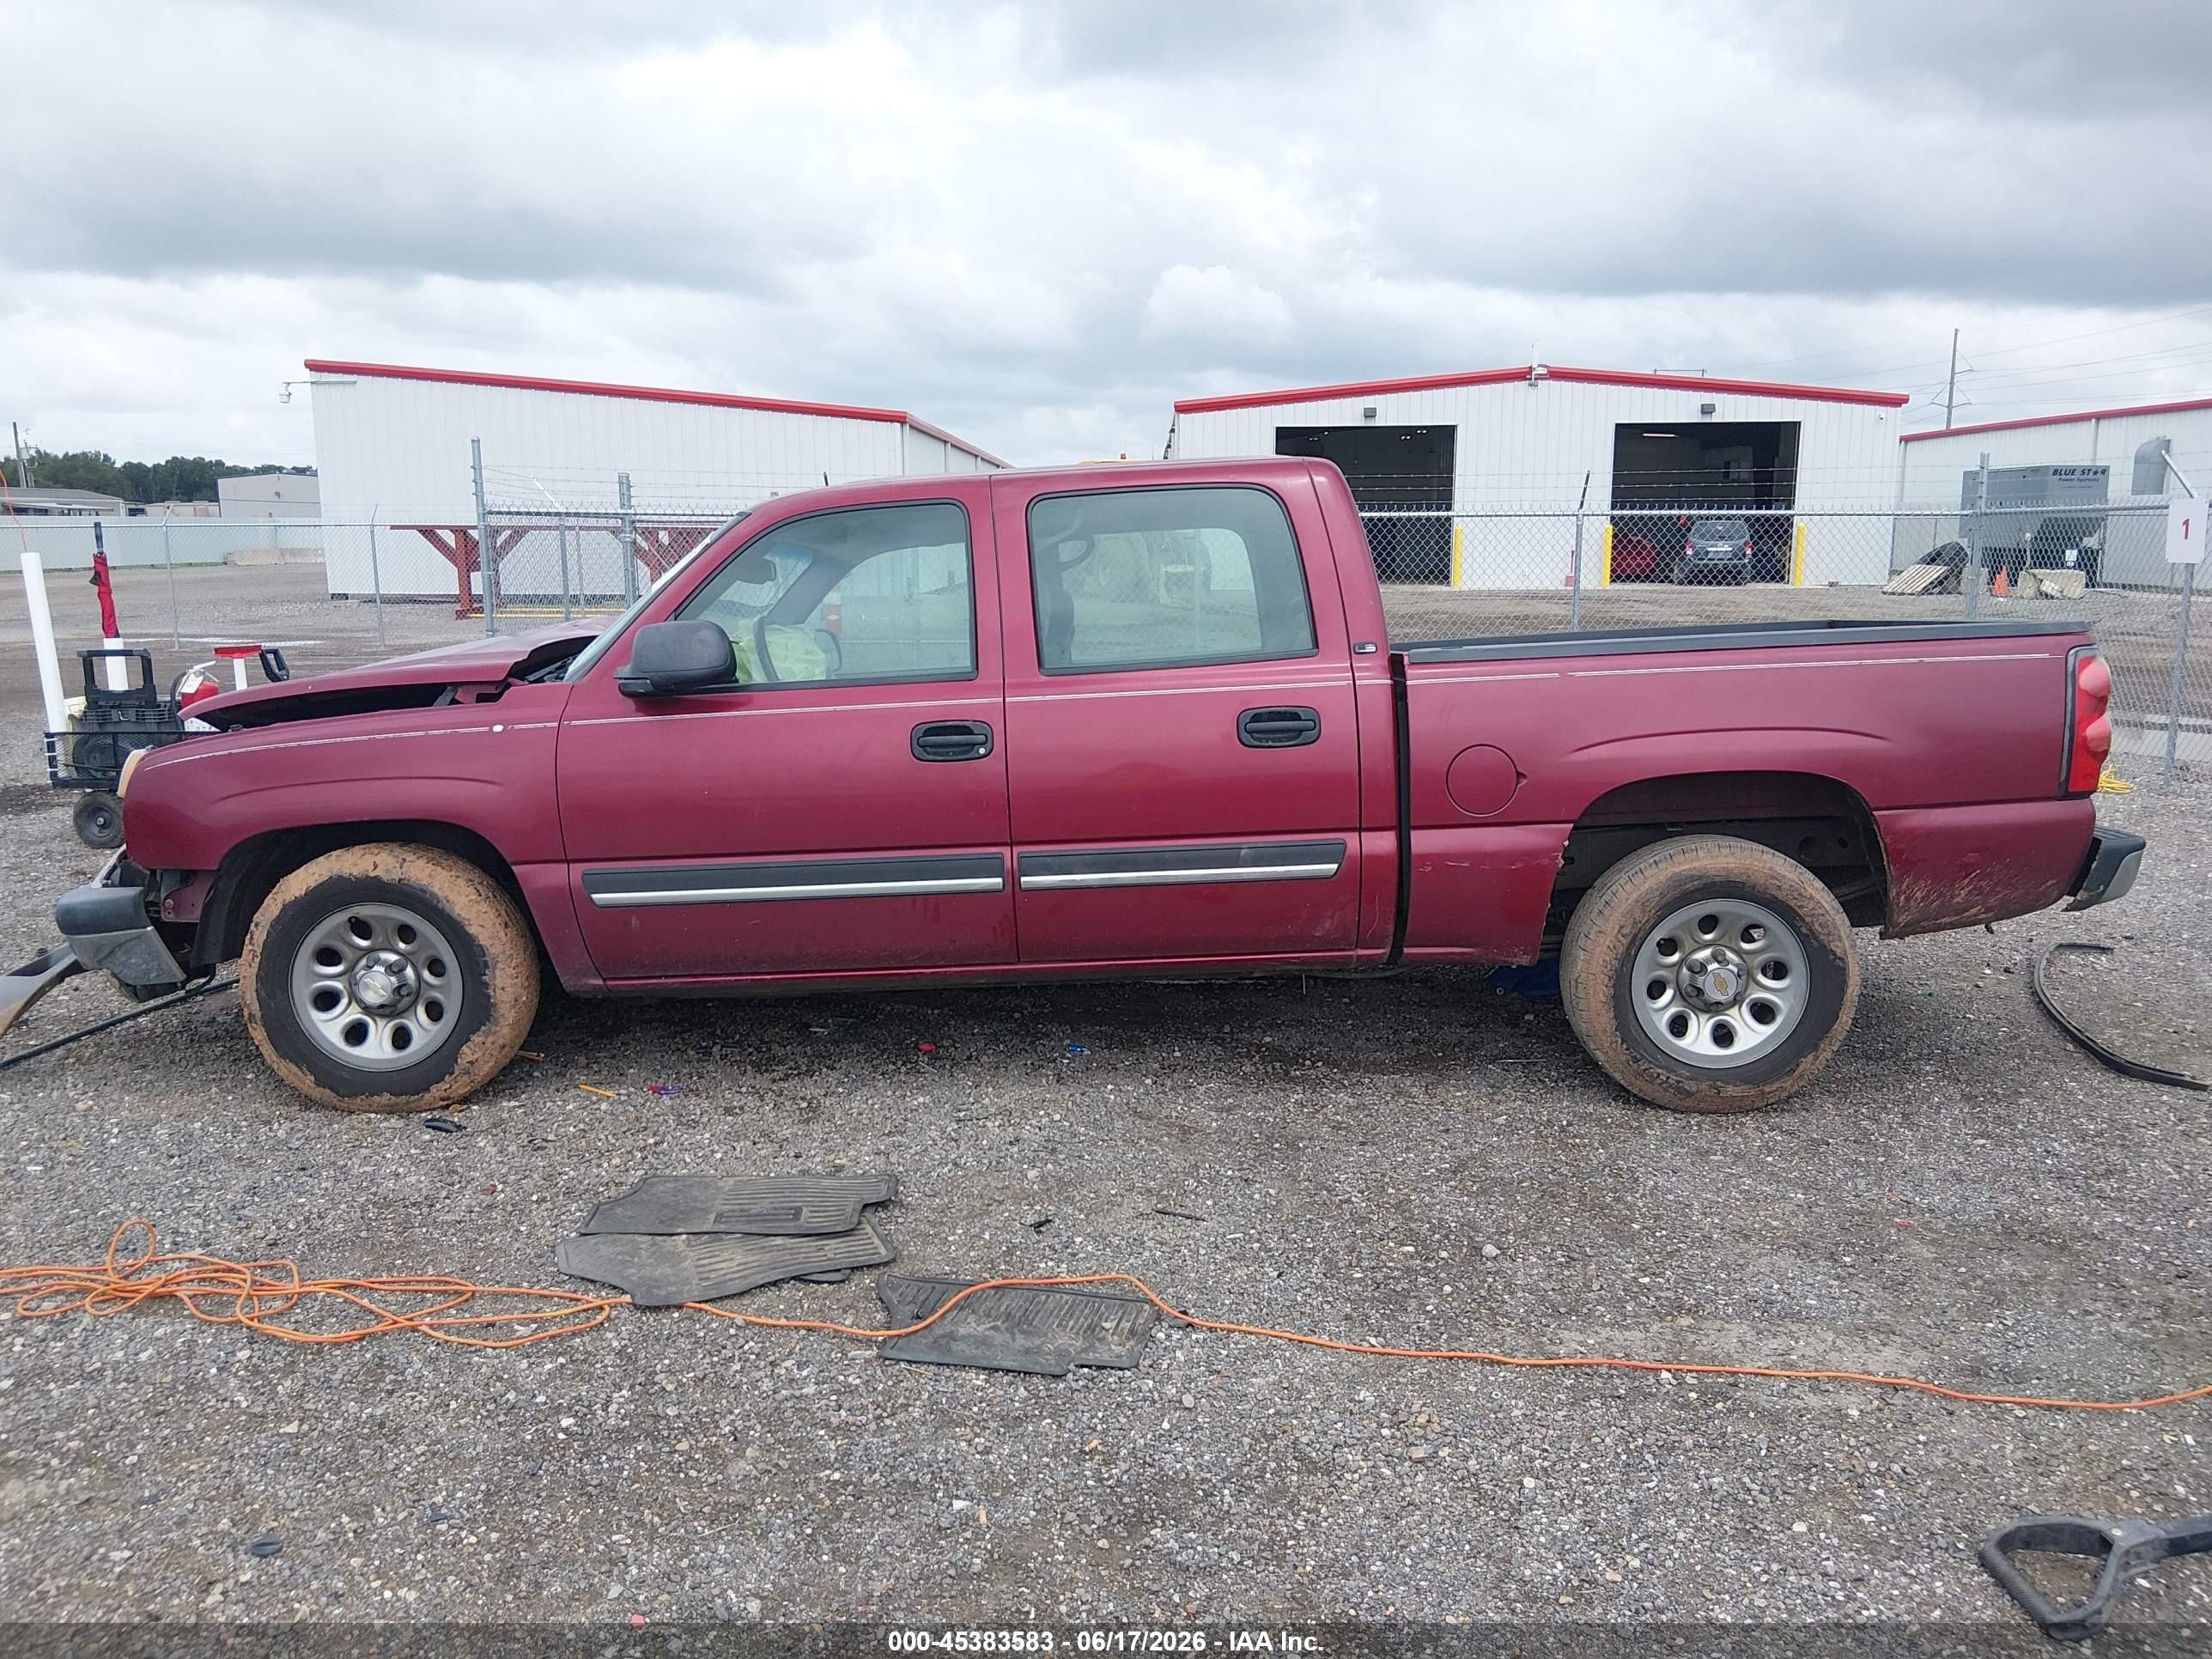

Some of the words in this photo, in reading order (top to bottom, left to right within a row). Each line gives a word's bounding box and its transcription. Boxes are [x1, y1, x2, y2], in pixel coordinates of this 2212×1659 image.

[2051, 468, 2077, 477] BLUE
[2182, 518, 2191, 540] 1
[1355, 644, 1376, 653] LS
